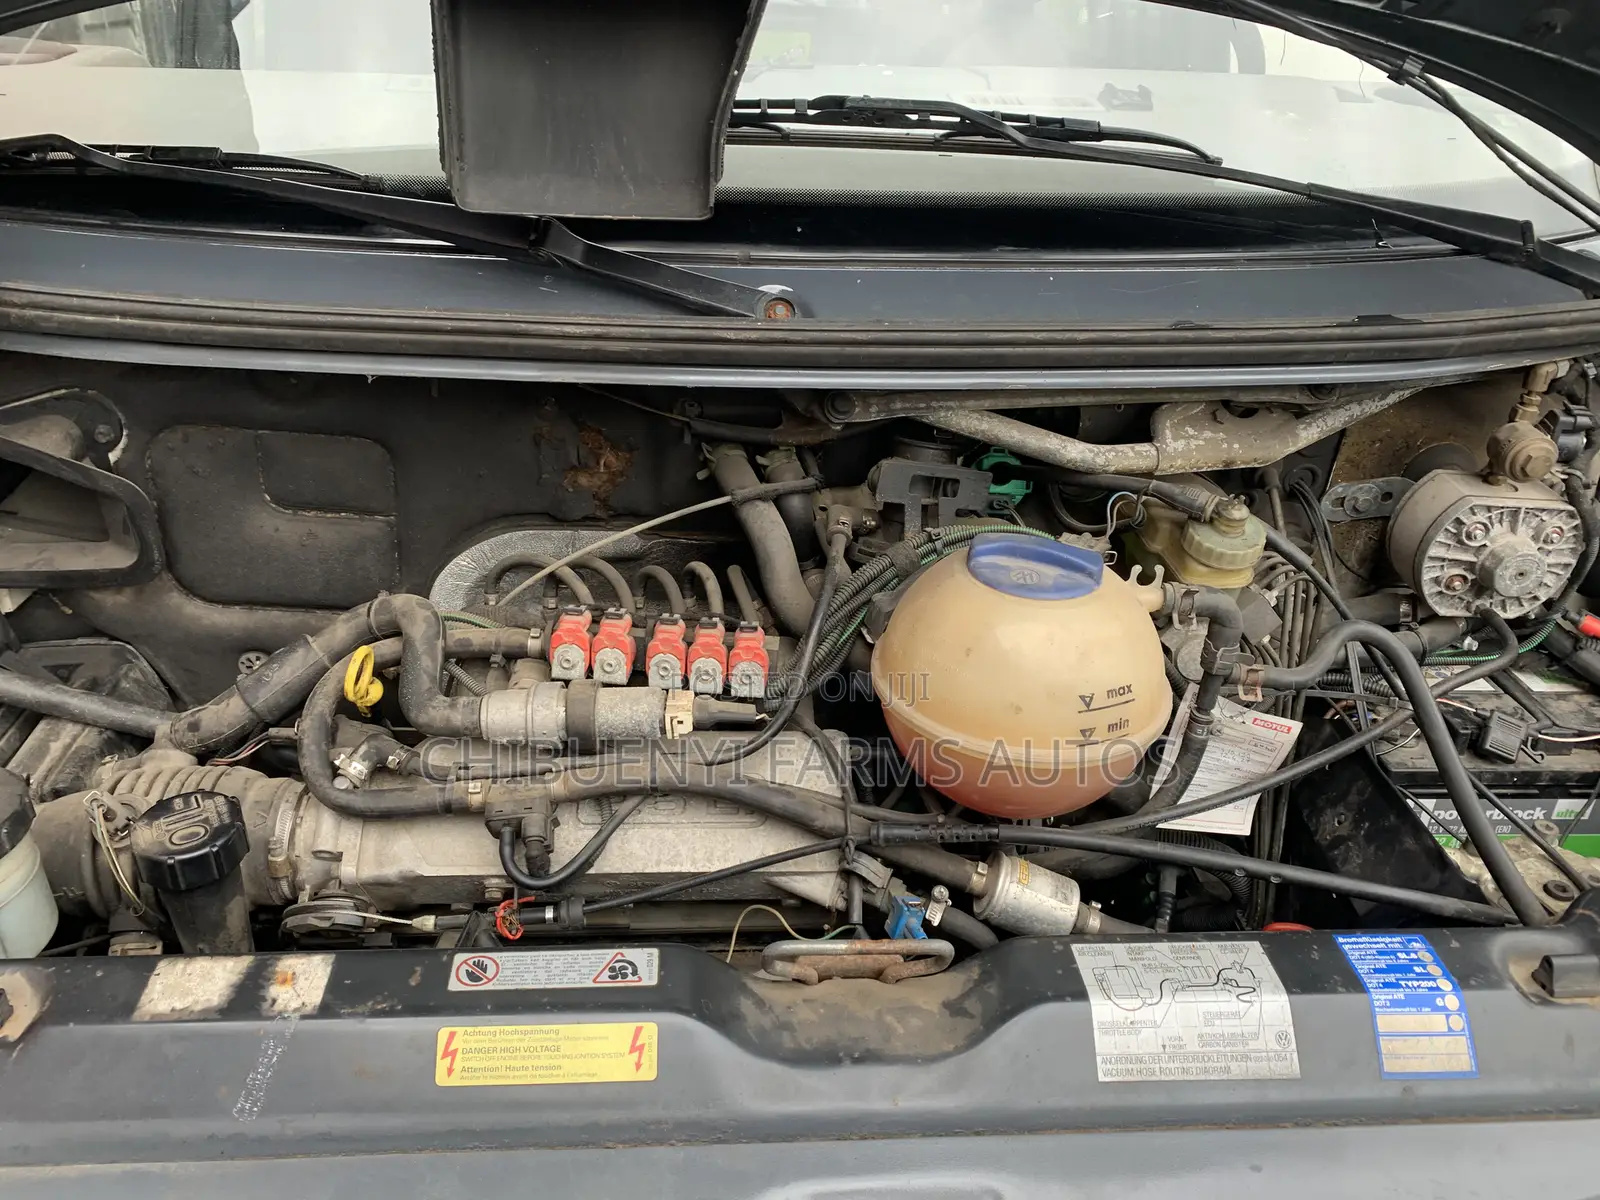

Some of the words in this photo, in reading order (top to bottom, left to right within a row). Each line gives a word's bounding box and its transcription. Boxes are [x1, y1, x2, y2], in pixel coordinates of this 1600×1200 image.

[1106, 684, 1133, 699] max
[1107, 717, 1130, 733] min
[161, 794, 210, 849] OIL
[1495, 825, 1511, 834] (EN)
[463, 1029, 497, 1038] Achtung
[499, 1028, 560, 1037] Hochspannung
[461, 1047, 498, 1055] DANGER
[500, 1046, 520, 1054] HIGH
[522, 1045, 561, 1054] VOLTAGE
[1101, 1055, 1148, 1065] ANORDNUNG
[1148, 1055, 1164, 1064] DER
[461, 1065, 503, 1074] Attention!
[504, 1064, 530, 1072] Haute
[532, 1064, 562, 1072] tension
[1101, 1067, 1135, 1078] VACUUM
[1137, 1067, 1157, 1077] HOSE
[1159, 1066, 1194, 1076] ROUTING
[1196, 1066, 1232, 1076] DIAGRAM
